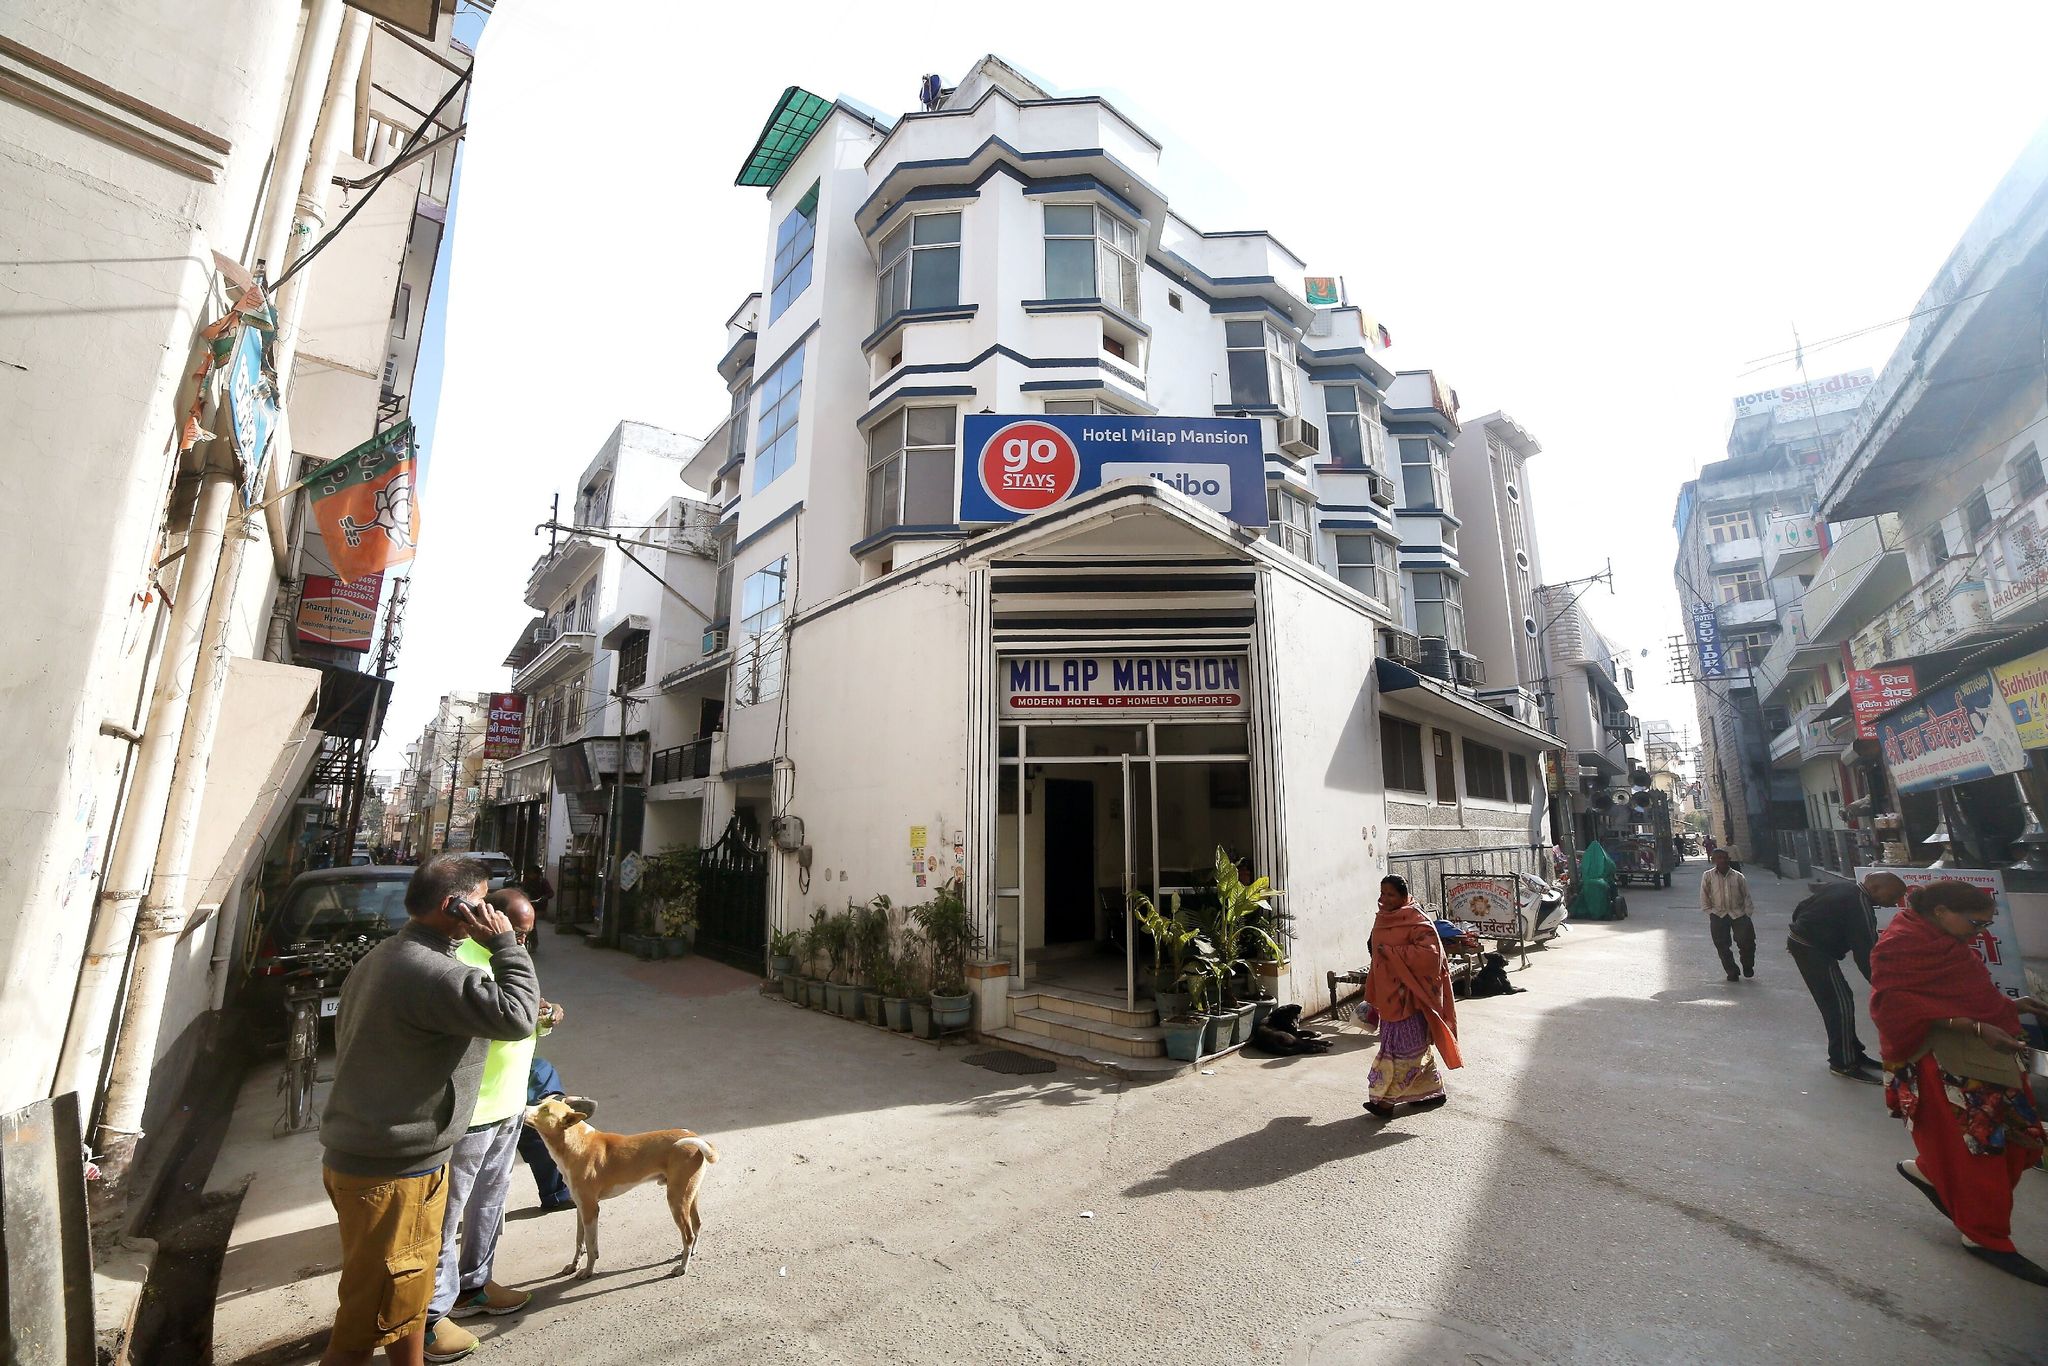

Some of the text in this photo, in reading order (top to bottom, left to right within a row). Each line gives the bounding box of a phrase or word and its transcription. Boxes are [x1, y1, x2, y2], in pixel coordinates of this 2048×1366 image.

[1735, 372, 1873, 408] HOTEL Suvidha
[1083, 428, 1248, 445] Hotel Milap Mansion
[1002, 437, 1058, 473] go
[1002, 473, 1055, 488] STAYS
[305, 602, 332, 613] Sharvan
[334, 607, 350, 616] Nath
[324, 614, 355, 625] Haridwar
[1010, 658, 1240, 692] MILAP MANSION
[1880, 674, 1909, 685] शिव
[1018, 695, 1232, 706] MODERN HOTEL OF HOMELY COMFORTS
[491, 706, 523, 720] होटल
